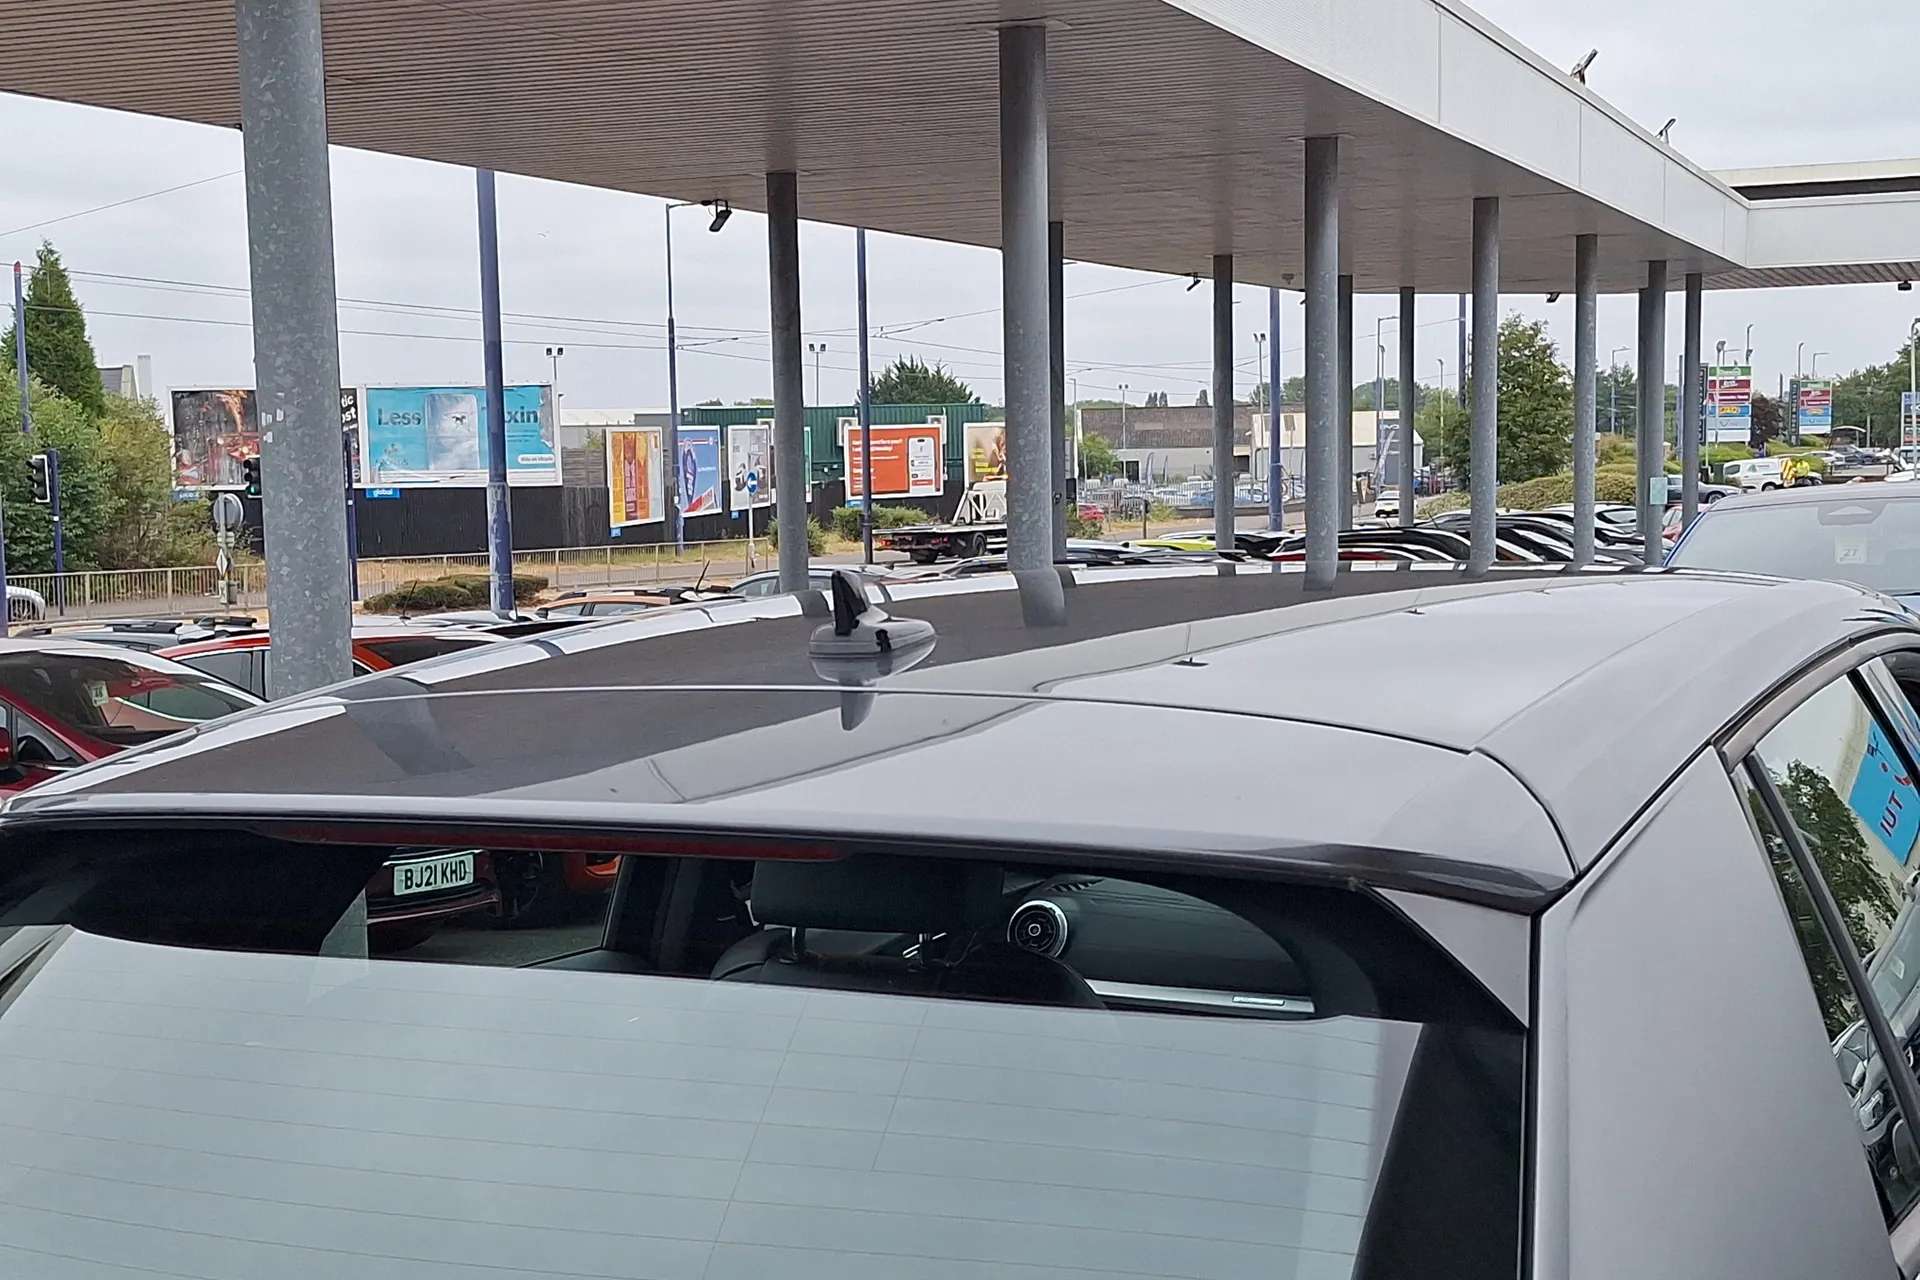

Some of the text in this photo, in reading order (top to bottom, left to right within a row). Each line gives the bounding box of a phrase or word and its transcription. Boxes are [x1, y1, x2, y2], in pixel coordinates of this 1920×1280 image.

[377, 407, 422, 426] Less
[404, 859, 467, 890] BJ21 KHD
